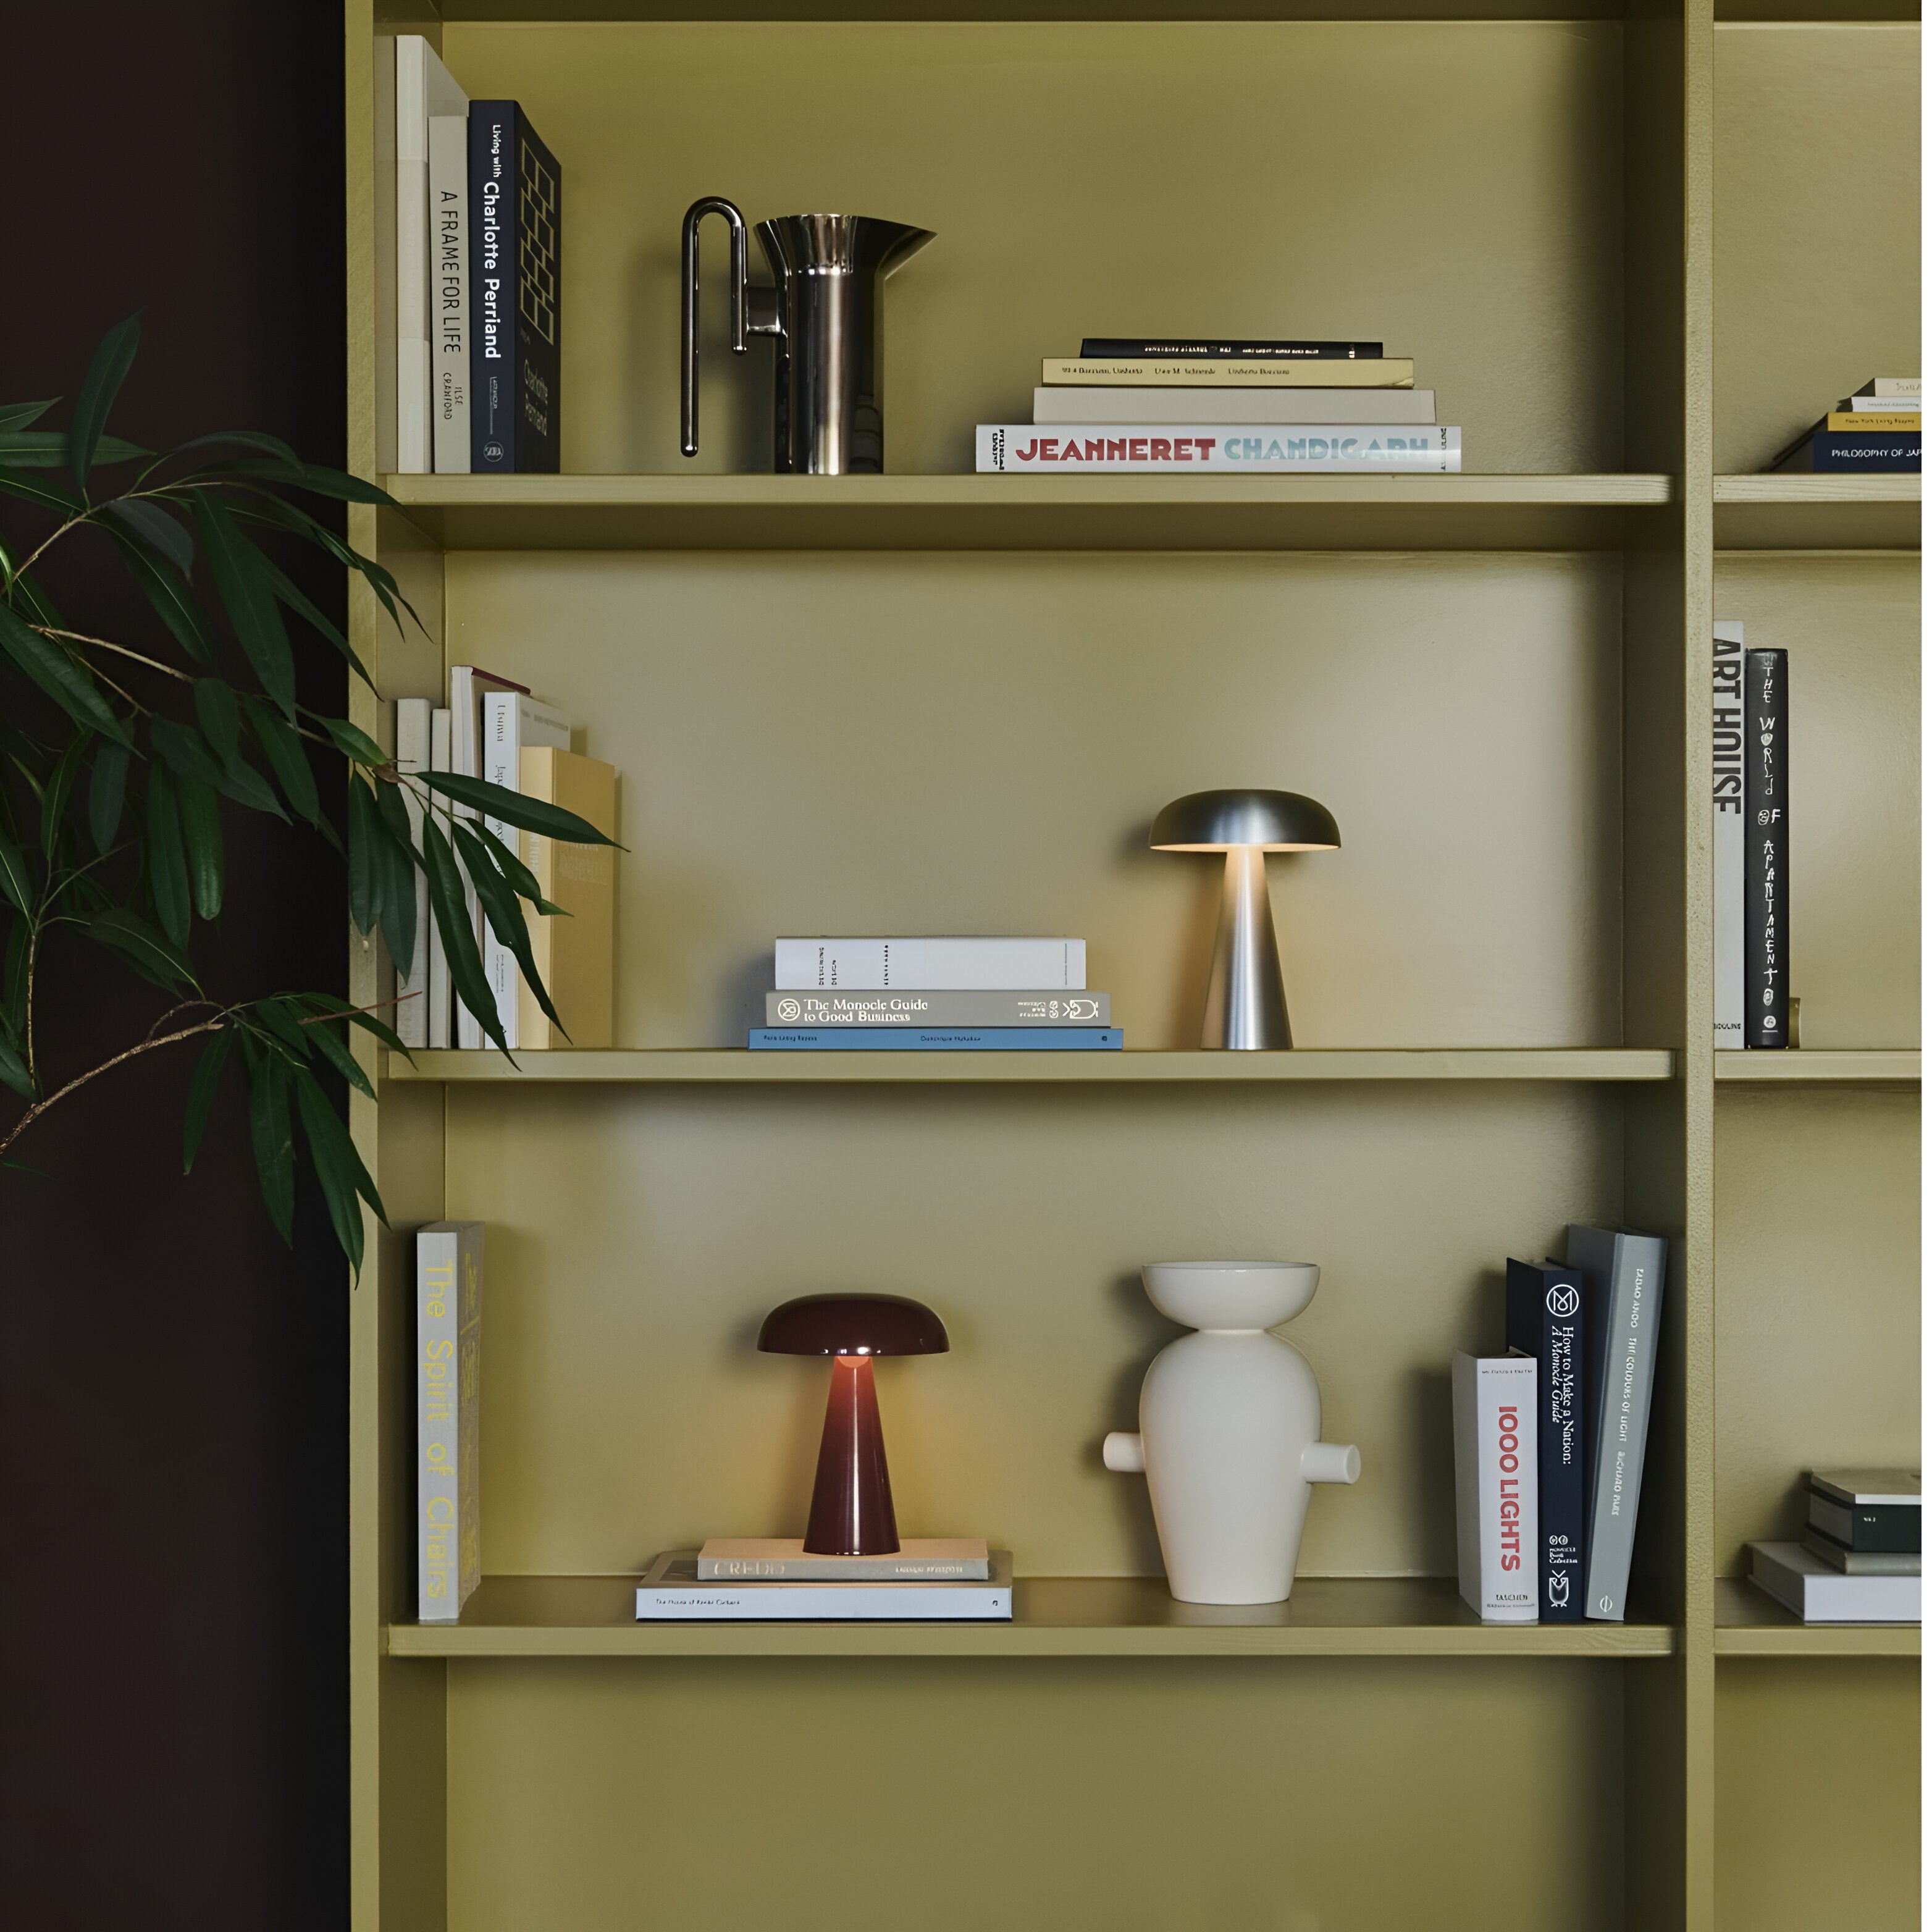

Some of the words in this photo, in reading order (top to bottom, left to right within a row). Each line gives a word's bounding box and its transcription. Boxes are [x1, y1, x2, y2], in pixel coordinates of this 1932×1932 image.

[492, 125, 501, 154] Living
[492, 157, 501, 178] with
[440, 191, 458, 203] A
[442, 211, 459, 271] FRAME
[484, 182, 501, 269] Charlotte
[442, 277, 460, 310] FOR
[443, 318, 461, 353] LIFE
[484, 279, 501, 358] Perriand
[1015, 438, 1216, 461] JEANNERET
[1891, 449, 1903, 458] OF
[1713, 638, 1741, 699] ART
[1713, 708, 1741, 815] HOUSE
[804, 999, 829, 1010] The
[834, 999, 887, 1010] Monocle
[890, 999, 928, 1010] Guide
[804, 1012, 815, 1022] to
[819, 1010, 852, 1022] Good
[424, 1261, 453, 1318] The
[1563, 1326, 1574, 1355] How
[422, 1340, 453, 1421] Spirit
[1563, 1358, 1572, 1371] to
[1552, 1389, 1563, 1424] Guide
[1563, 1373, 1574, 1407] Make
[426, 1443, 455, 1476] of
[1500, 1479, 1521, 1571] LIGHTS
[426, 1496, 454, 1599] Chairs
